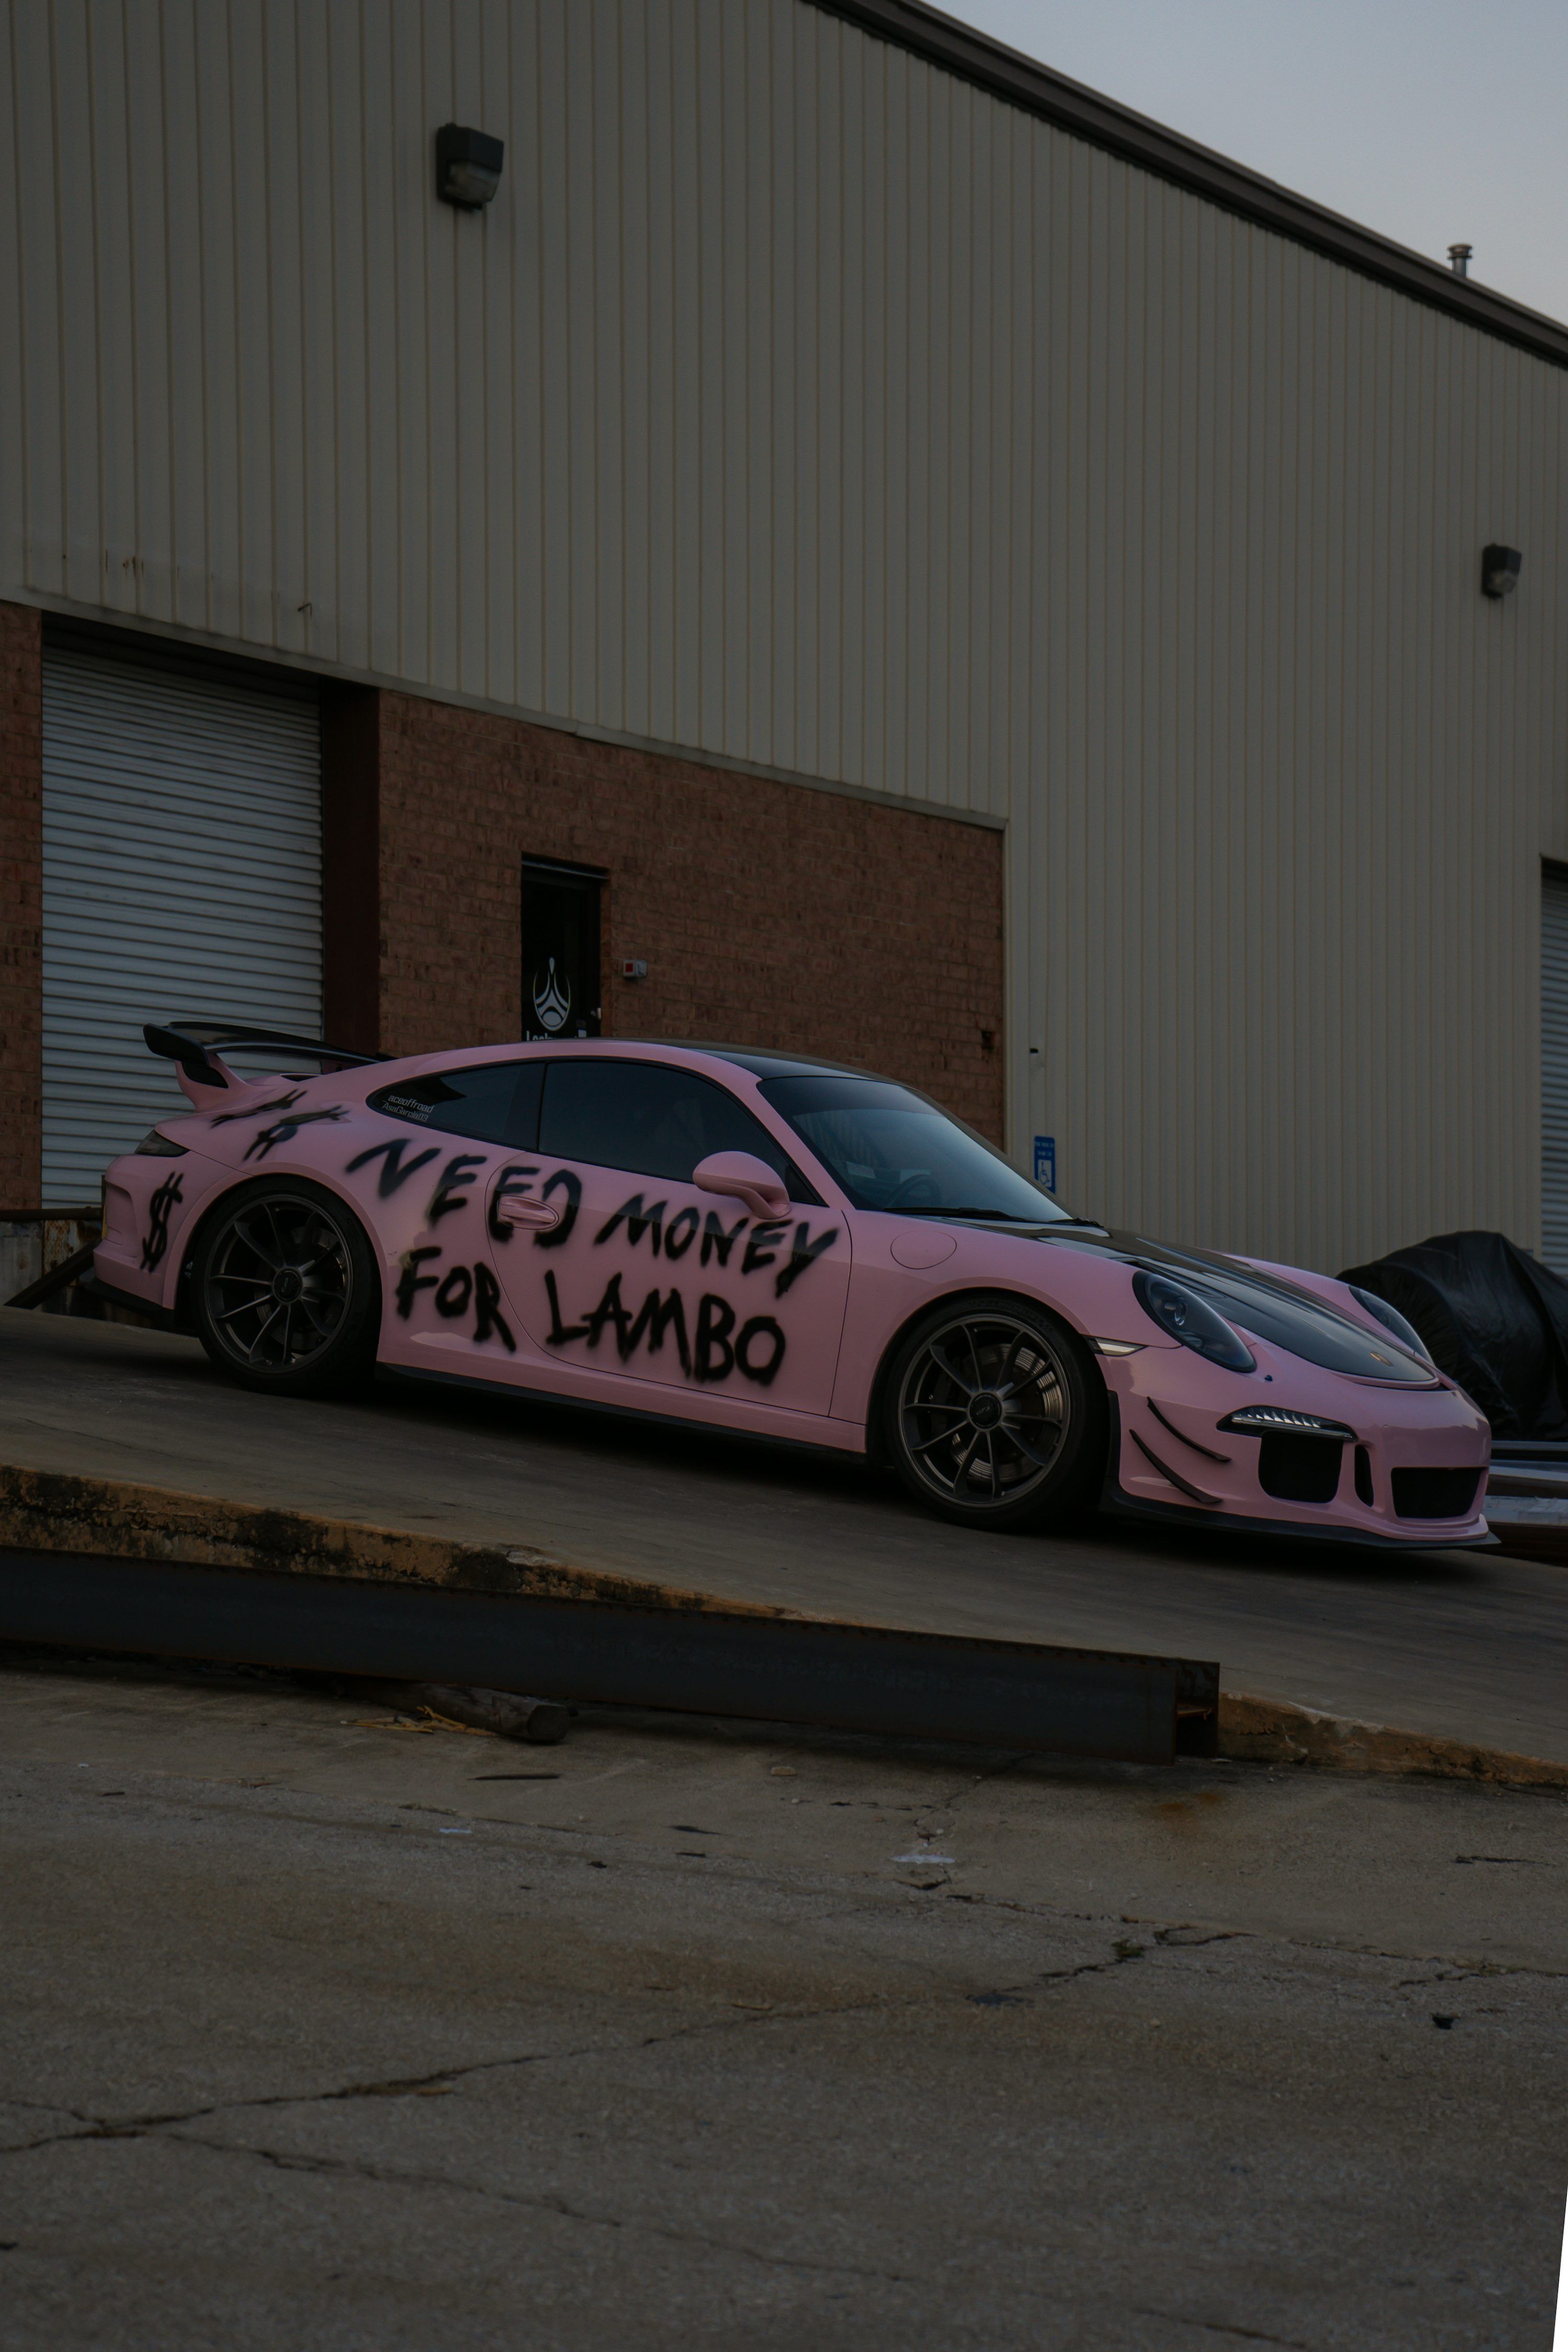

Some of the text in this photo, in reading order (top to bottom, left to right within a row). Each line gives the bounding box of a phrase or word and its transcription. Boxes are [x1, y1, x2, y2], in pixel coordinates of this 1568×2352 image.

[388, 1096, 435, 1113] aceoffroad
[344, 1138, 839, 1296] NEED MONEY
[396, 1246, 786, 1385] FOR LAMBO
